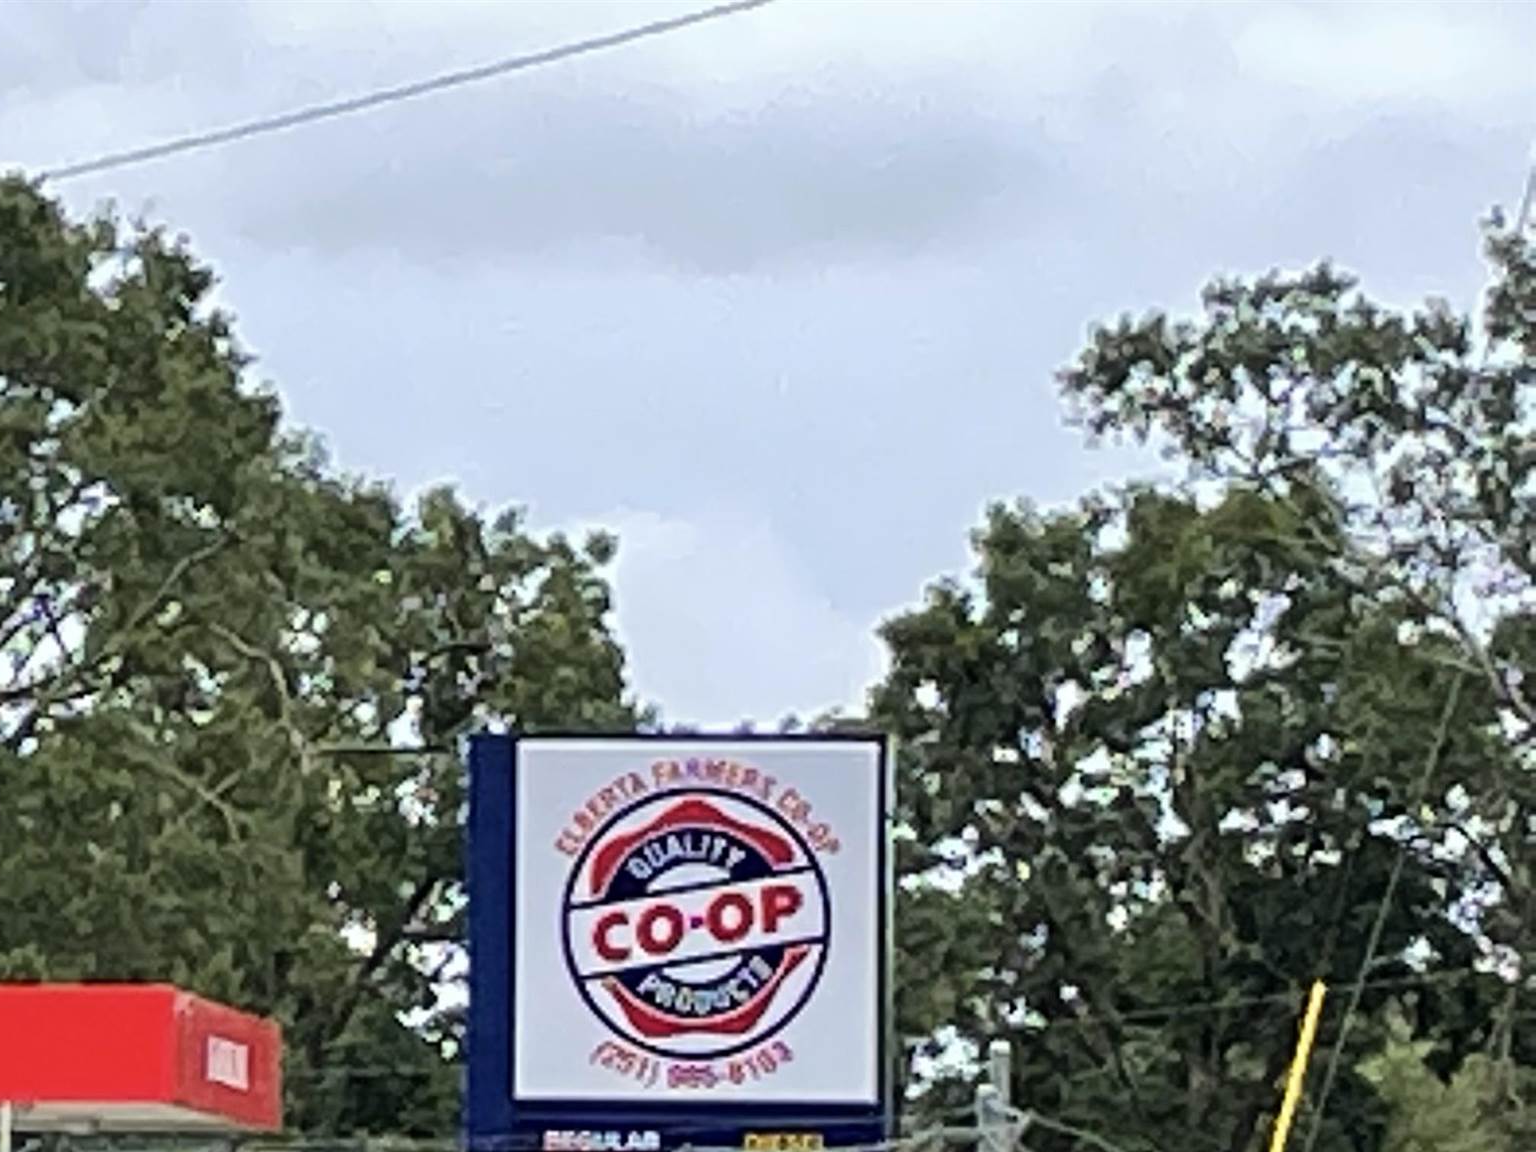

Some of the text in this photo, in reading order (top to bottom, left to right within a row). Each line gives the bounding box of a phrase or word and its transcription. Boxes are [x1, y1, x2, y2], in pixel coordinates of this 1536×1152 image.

[626, 833, 747, 878] QUALITY
[592, 885, 803, 962] CO-OP
[543, 1130, 661, 1151] REGULAR
